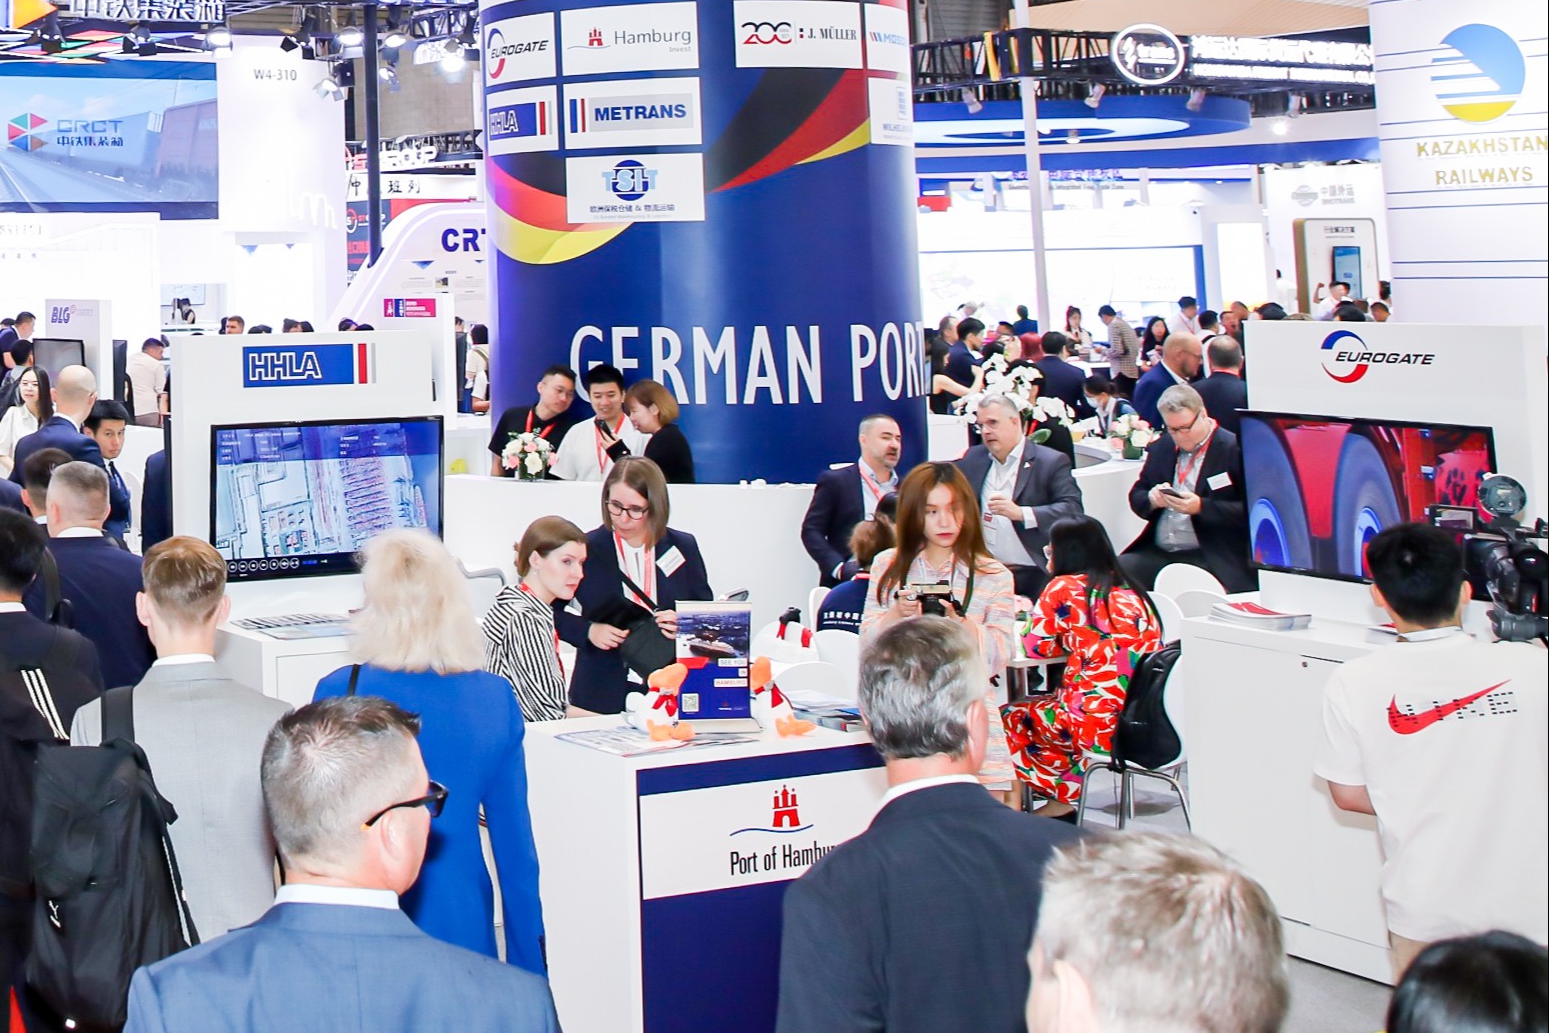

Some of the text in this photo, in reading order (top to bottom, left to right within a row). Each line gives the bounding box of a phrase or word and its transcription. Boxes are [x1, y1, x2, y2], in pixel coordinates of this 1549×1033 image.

[614, 27, 691, 45] Hamburg
[807, 28, 816, 40] J.
[819, 26, 857, 41] MÜLLER
[491, 39, 549, 59] EUROGATE
[253, 68, 297, 81] W4-310
[594, 104, 687, 122] METRANS
[57, 119, 123, 133] CRCT
[1416, 135, 1549, 157] KAZAKHSTAN
[350, 174, 421, 197] 中班列
[1435, 166, 1534, 186] RAILWAYS
[441, 228, 486, 252] CR
[51, 307, 70, 324] BLG
[248, 351, 322, 381] HHLA
[1335, 351, 1435, 365] EUROGATE
[730, 851, 758, 876] Port
[764, 846, 777, 870] of
